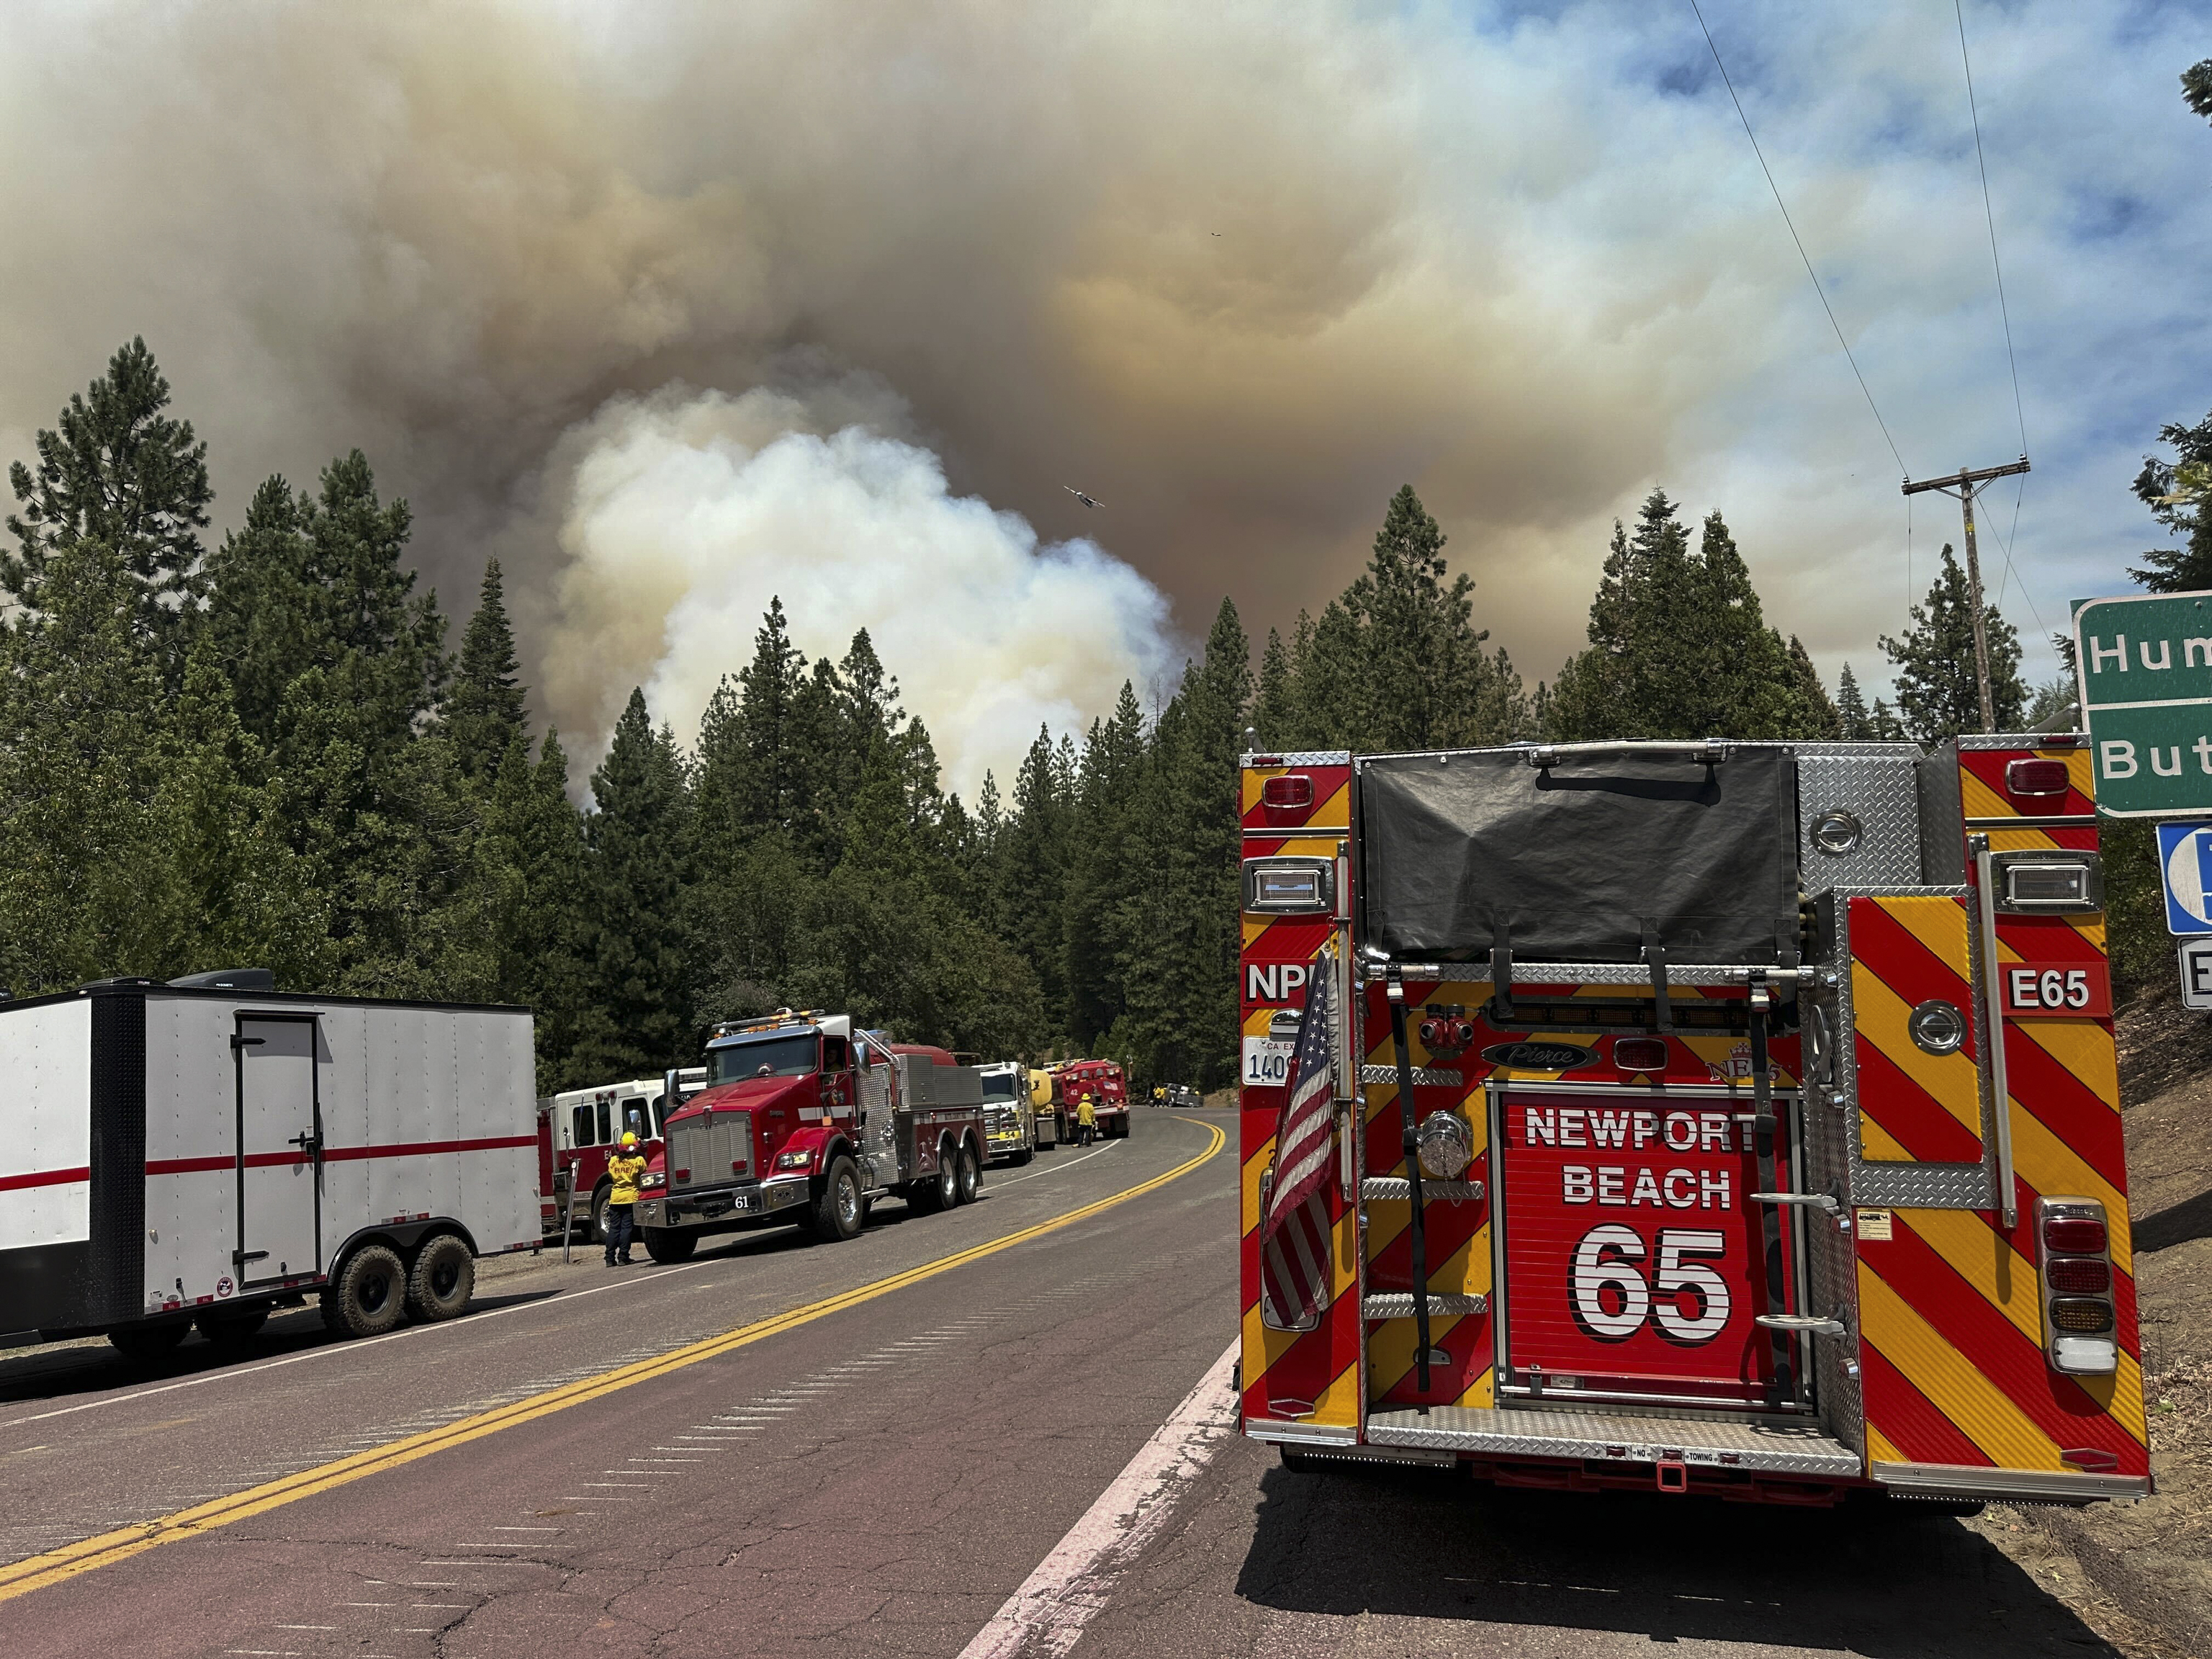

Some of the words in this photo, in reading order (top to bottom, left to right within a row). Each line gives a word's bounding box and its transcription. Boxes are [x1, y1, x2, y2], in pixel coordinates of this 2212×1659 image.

[2010, 969, 2089, 1007] E65
[1507, 1045, 1574, 1064] Pierce
[1706, 1059, 1783, 1081] NE5
[1526, 1107, 1756, 1152] NEWPORT
[735, 1195, 749, 1209] 61
[1563, 1165, 1731, 1209] BEACH
[1574, 1224, 1730, 1340] 65
[1689, 1452, 1713, 1462] TOWING
